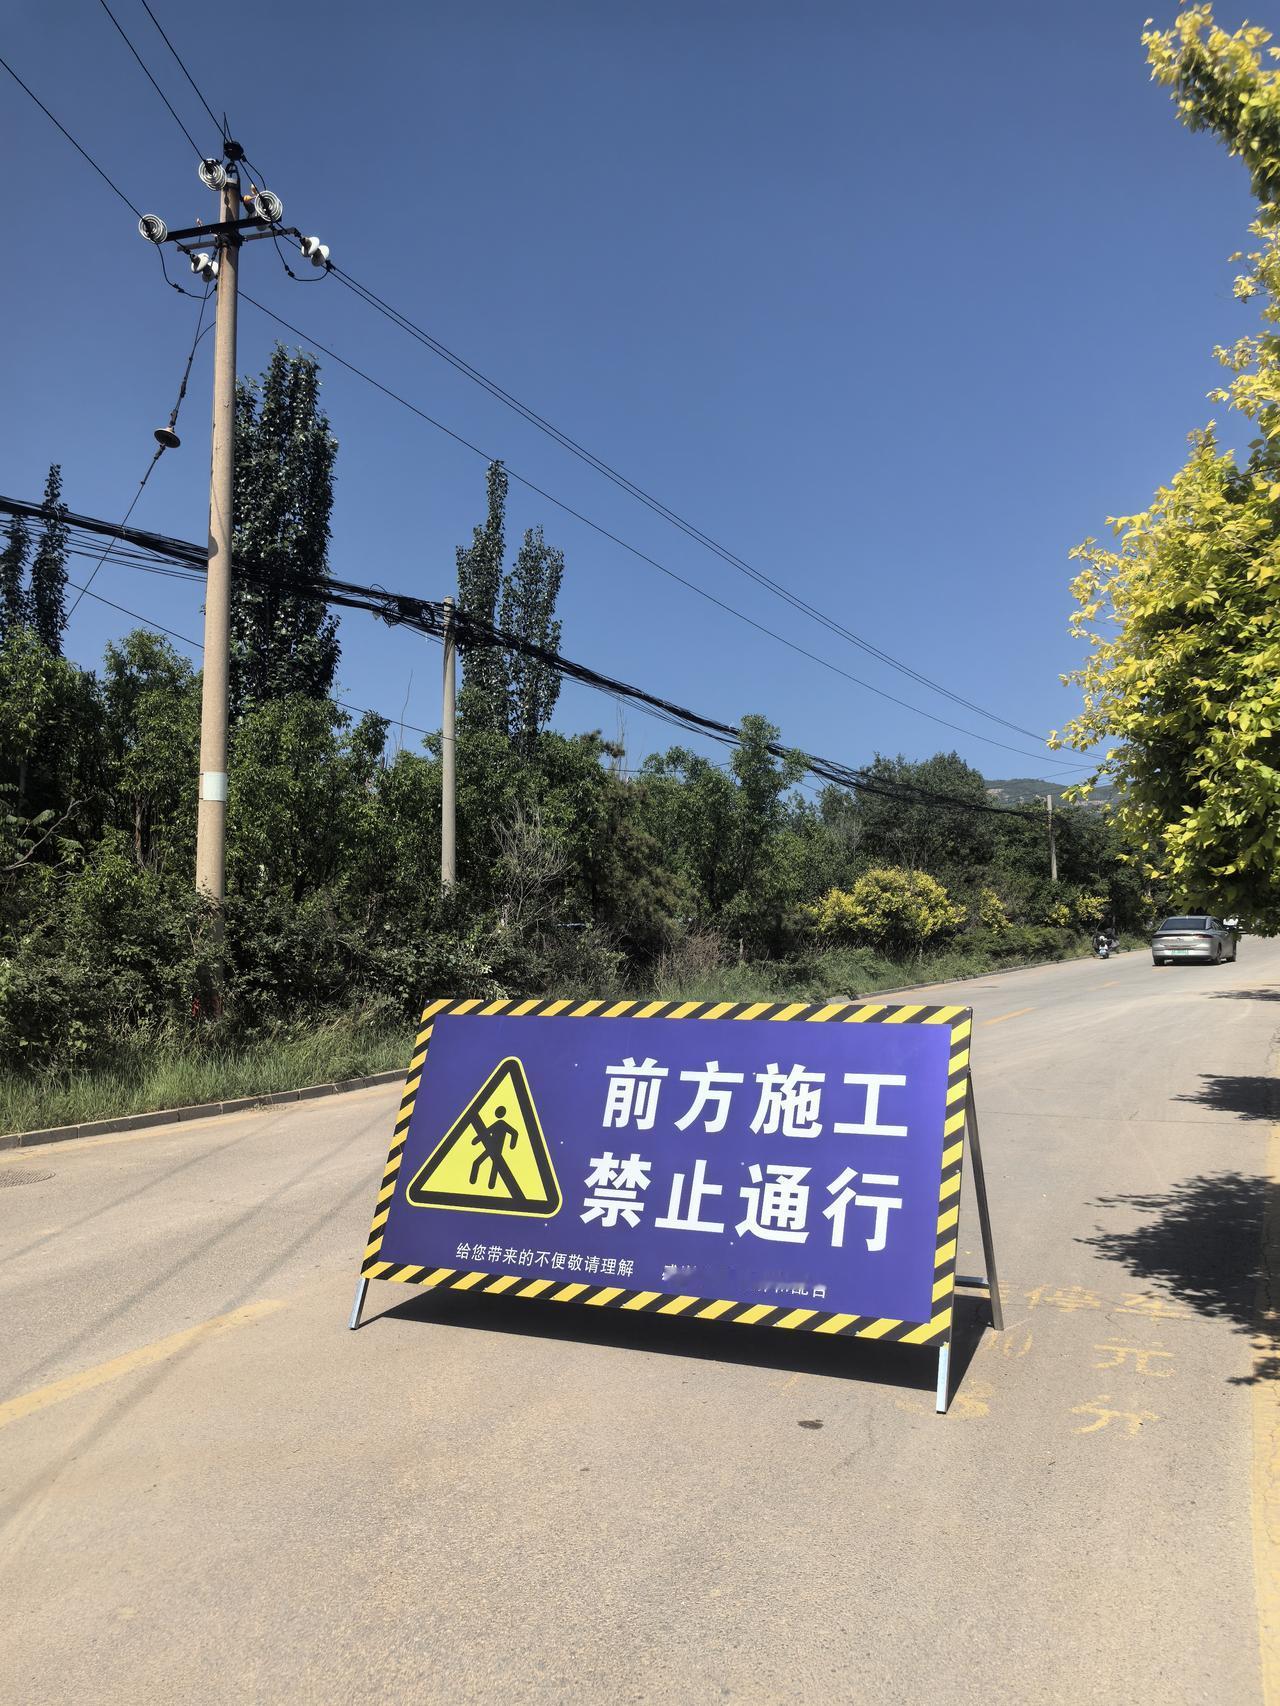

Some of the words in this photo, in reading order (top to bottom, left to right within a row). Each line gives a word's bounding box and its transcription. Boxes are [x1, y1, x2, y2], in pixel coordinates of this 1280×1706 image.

[602, 1056, 909, 1139] 前方施工
[579, 1151, 903, 1252] 禁止通行
[455, 1242, 635, 1278] 给您带来的不便敬请理解
[978, 1284, 1193, 1322] 停车
